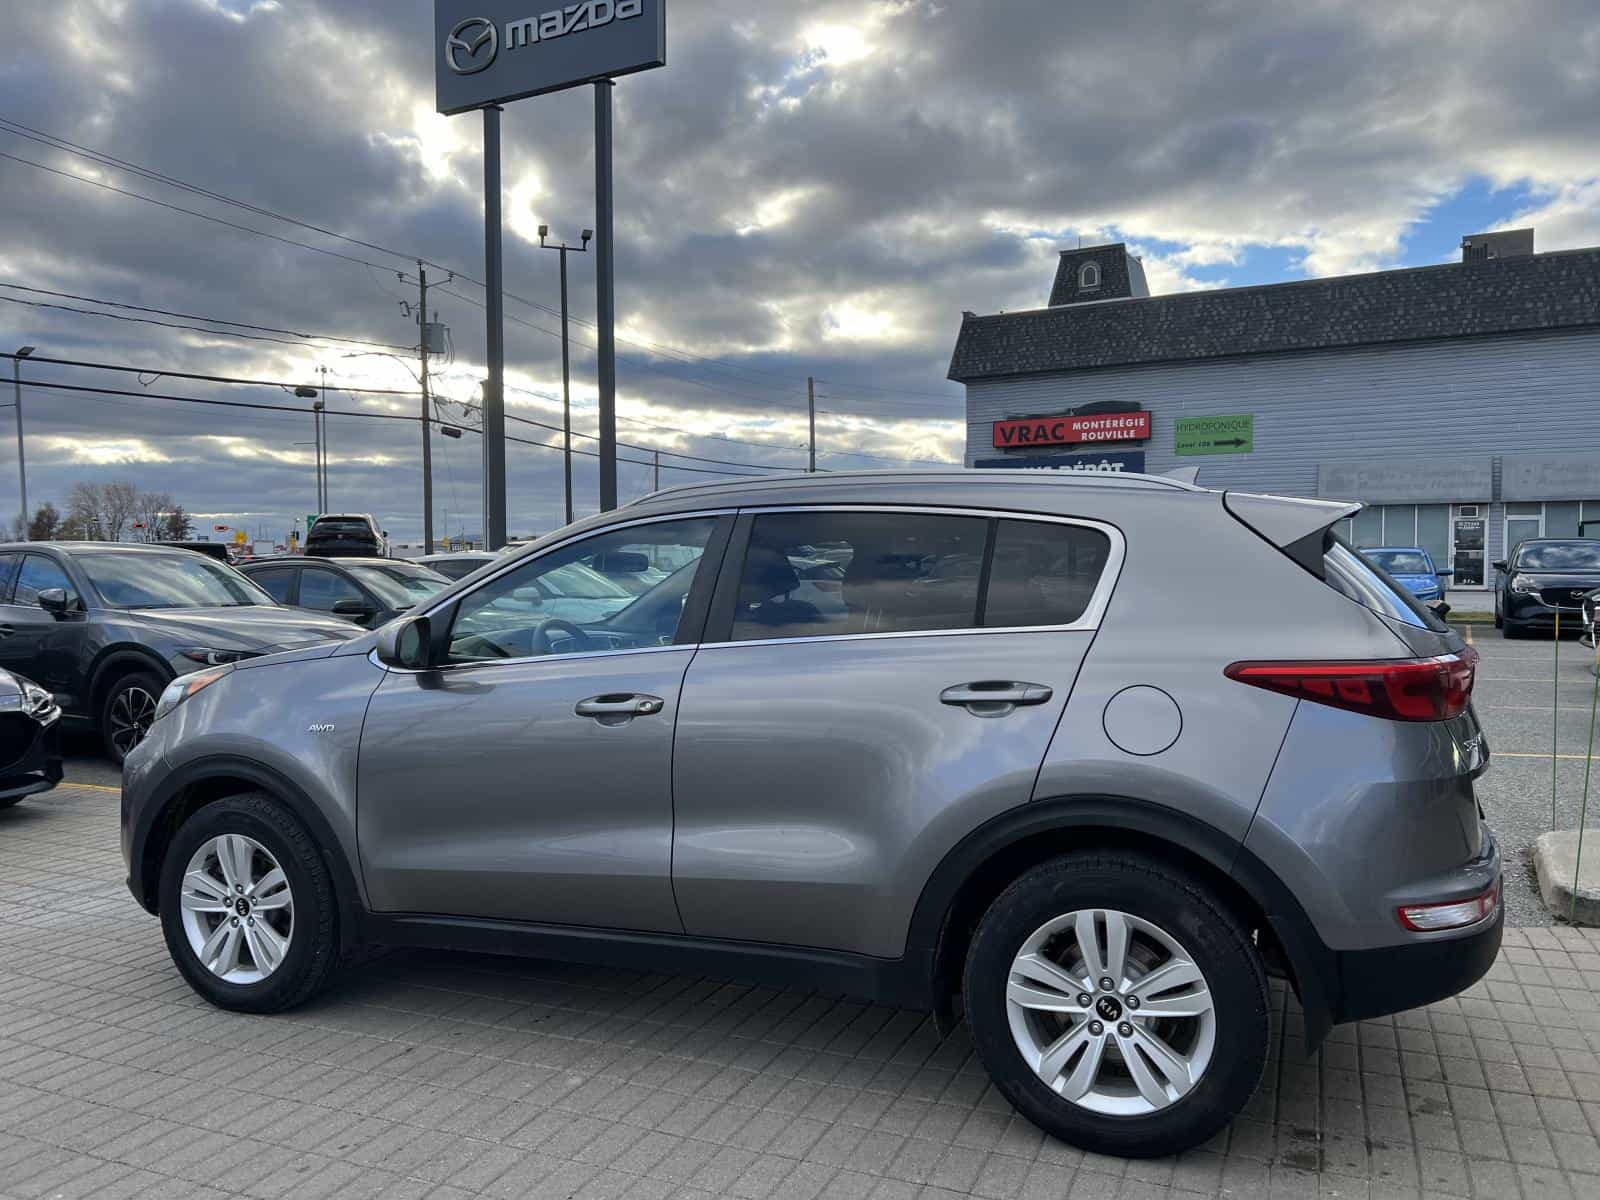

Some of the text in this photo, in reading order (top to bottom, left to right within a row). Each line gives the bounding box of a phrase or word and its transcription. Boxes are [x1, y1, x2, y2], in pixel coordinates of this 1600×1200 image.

[505, 0, 642, 49] mazda
[1072, 417, 1145, 431] MONTÉRÉGIE
[1176, 419, 1249, 432] HYDROPONIQUE
[1000, 422, 1065, 443] VRAC
[1081, 429, 1137, 441] ROUVILLE
[307, 723, 335, 732] AWD
[1098, 999, 1118, 1019] KIA
